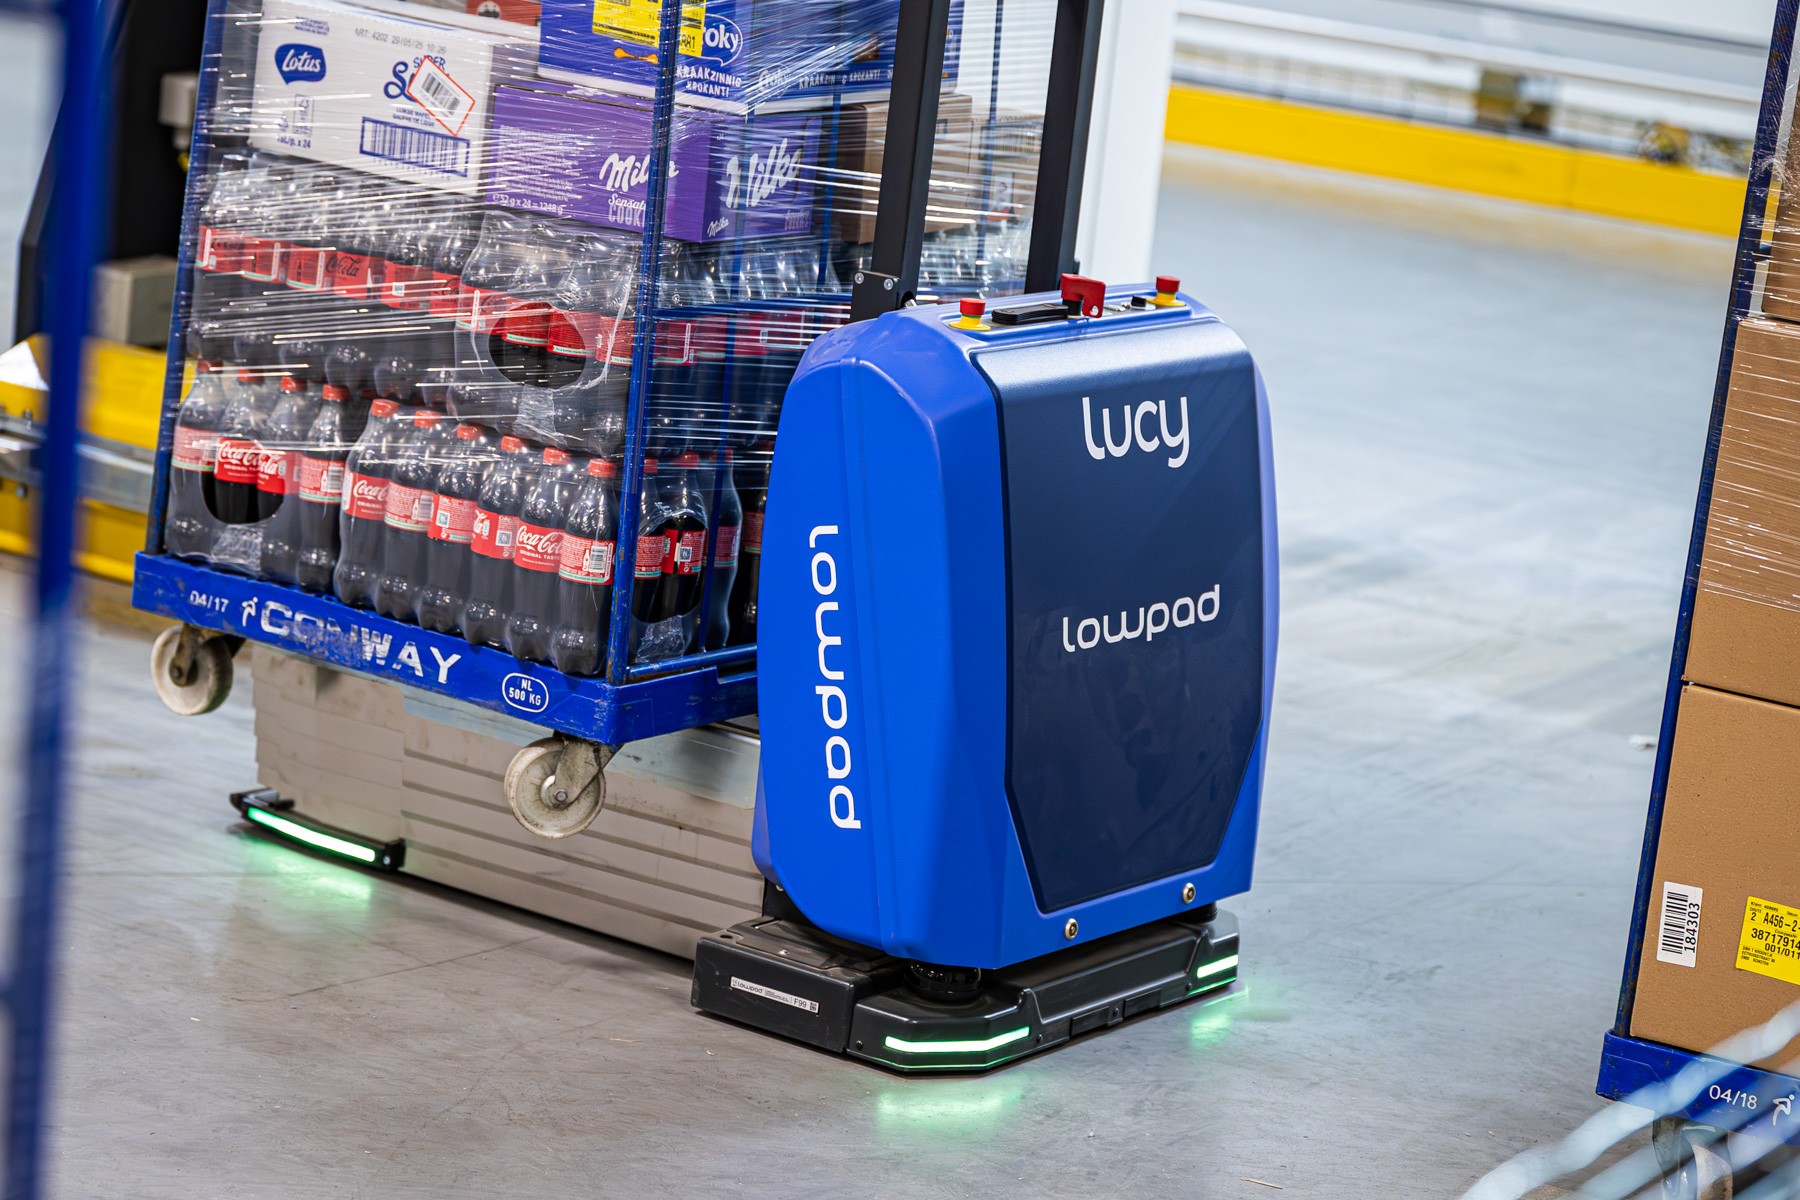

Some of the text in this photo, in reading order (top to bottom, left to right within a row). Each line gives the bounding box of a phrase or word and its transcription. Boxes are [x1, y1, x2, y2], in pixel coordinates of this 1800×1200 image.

[703, 24, 739, 52] oky
[282, 49, 321, 72] Lotus
[677, 65, 742, 87] KRAAKZINNIG
[726, 137, 801, 209] Milka
[1083, 396, 1190, 469] lucy
[189, 590, 230, 613] 04/17
[1062, 583, 1220, 653] lowpad
[521, 679, 533, 691] NL
[809, 525, 862, 829] lowpad
[509, 687, 542, 706] 500 KG
[1684, 902, 1700, 954] 184303
[1750, 911, 1757, 921] 2
[794, 998, 807, 1009] F99
[1709, 1084, 1758, 1110] 04/18
